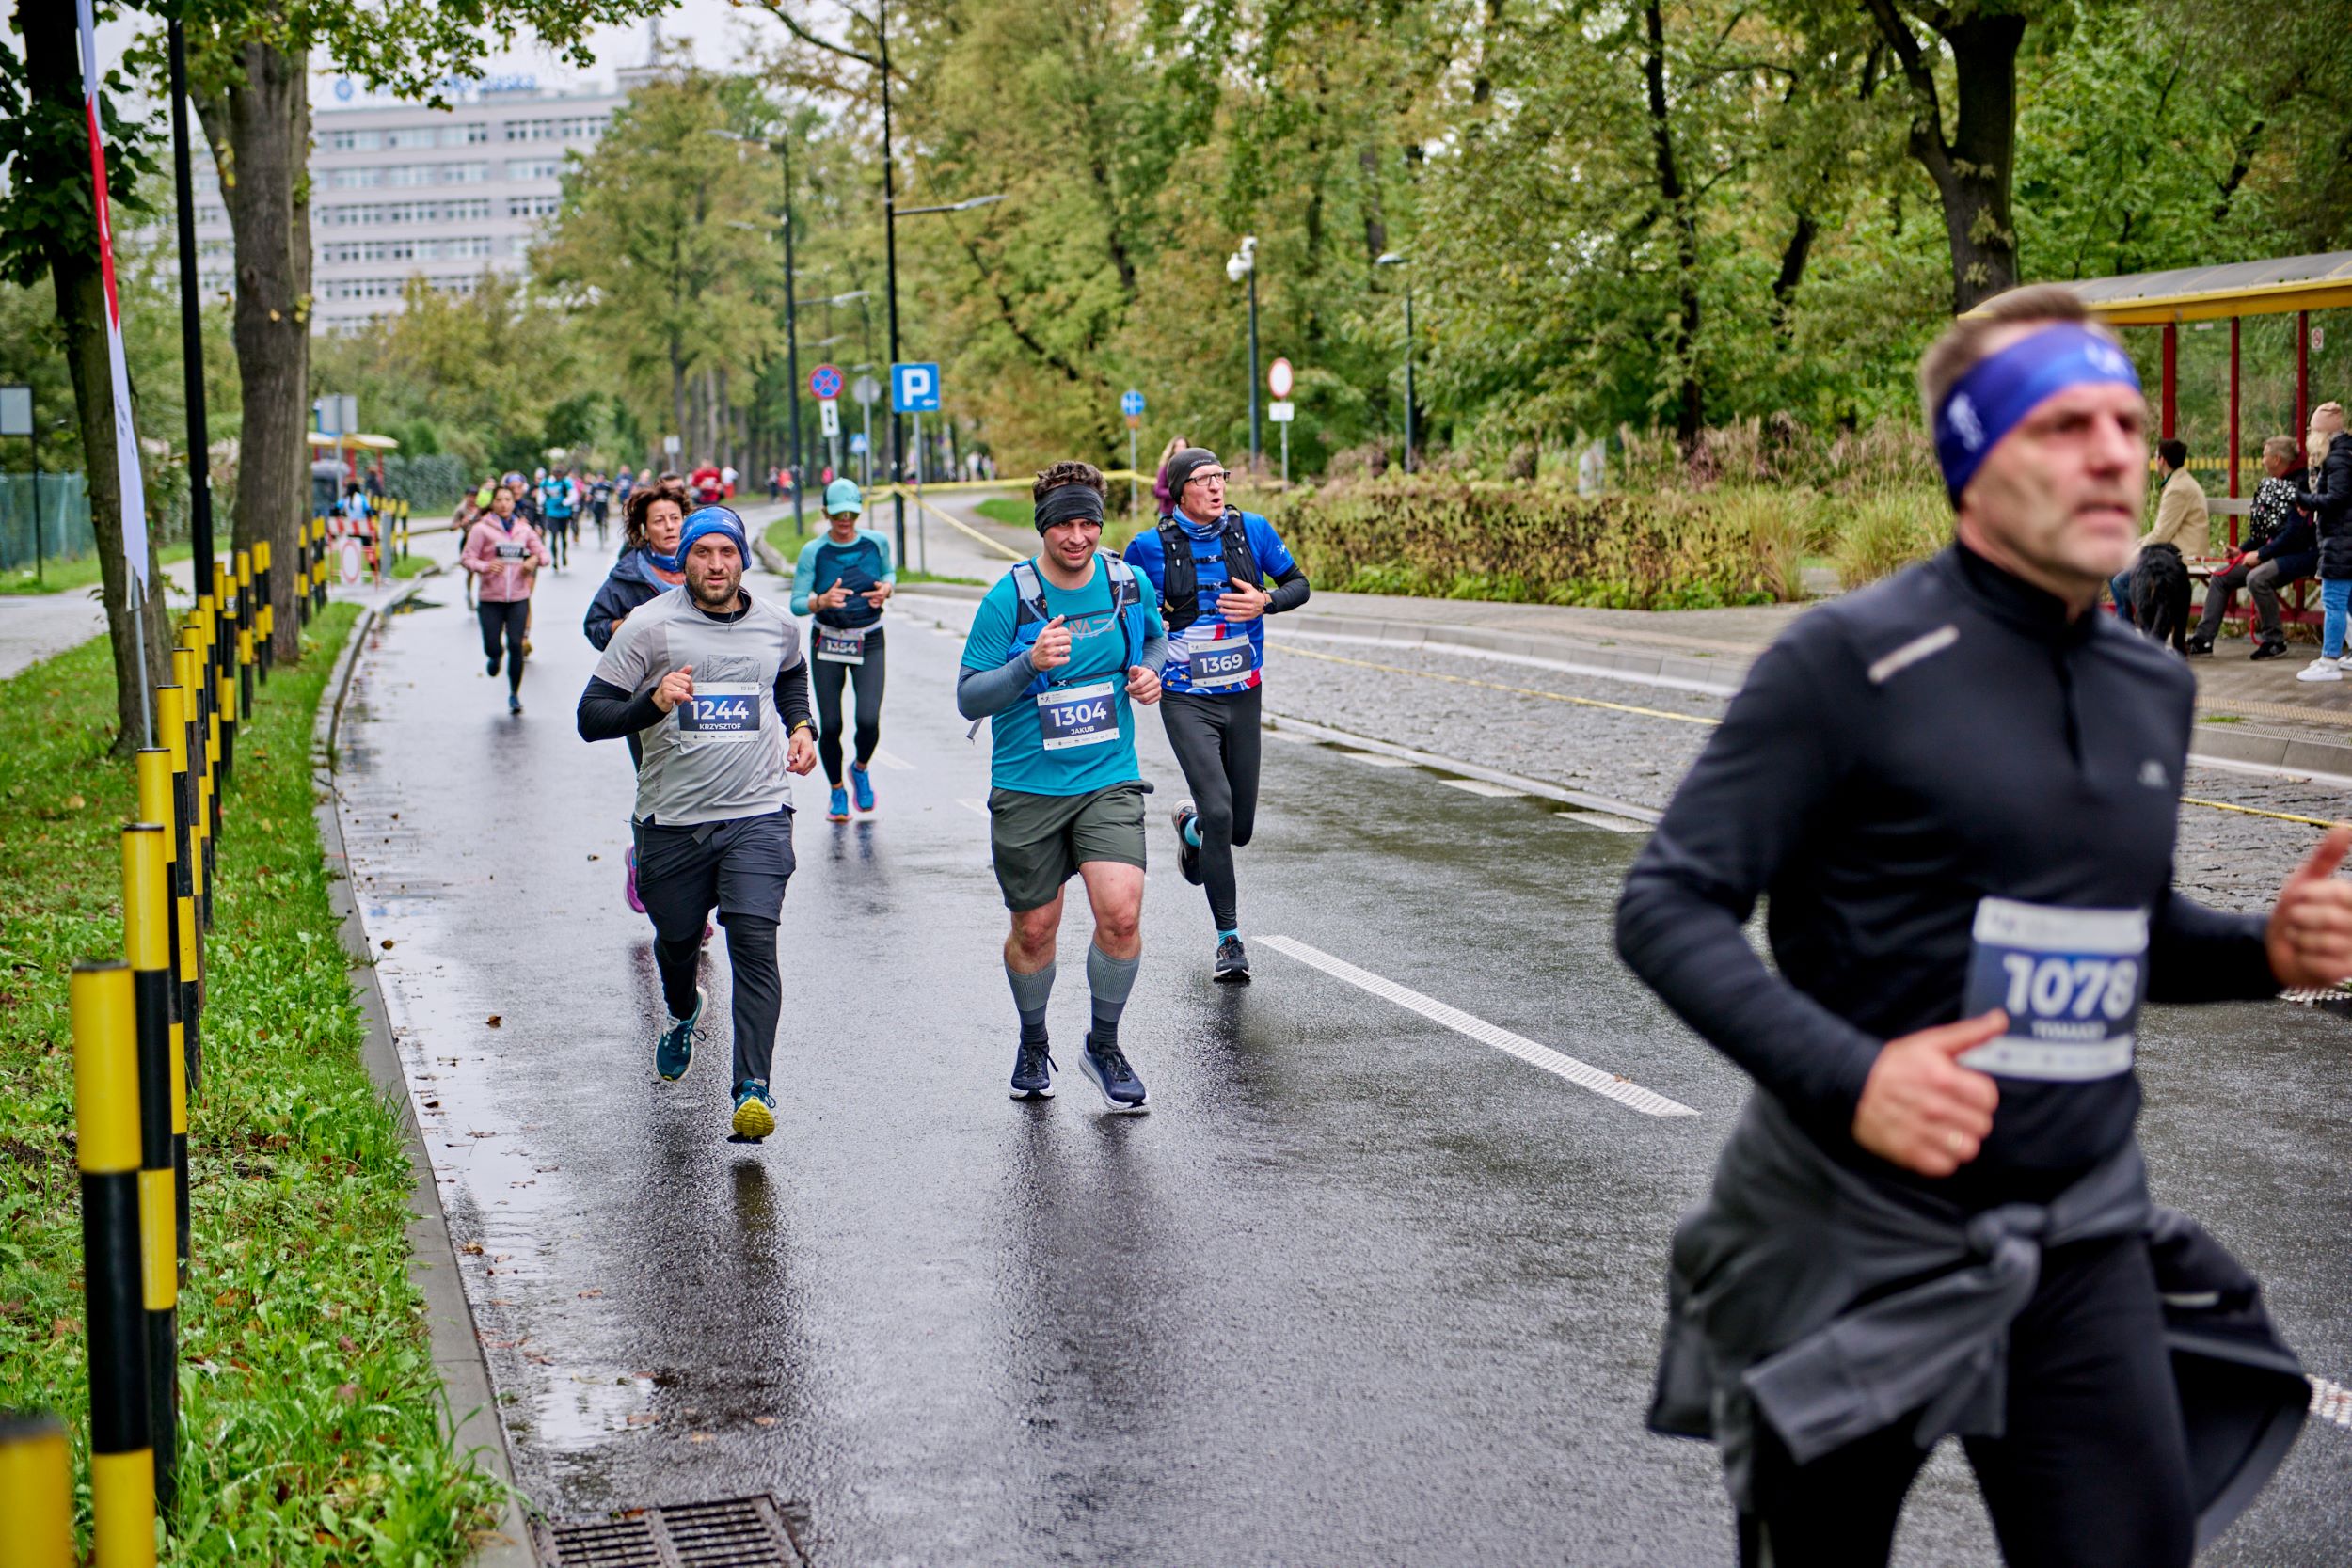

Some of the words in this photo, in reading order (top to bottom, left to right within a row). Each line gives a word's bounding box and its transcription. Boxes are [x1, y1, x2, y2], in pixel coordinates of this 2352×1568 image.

[901, 368, 930, 407] P
[826, 639, 858, 655] 1354
[1200, 653, 1243, 673] 1369
[690, 700, 750, 720] 1244
[1050, 701, 1107, 727] 1304
[1070, 725, 1095, 736] JAKUB
[2002, 953, 2138, 1020] 1078
